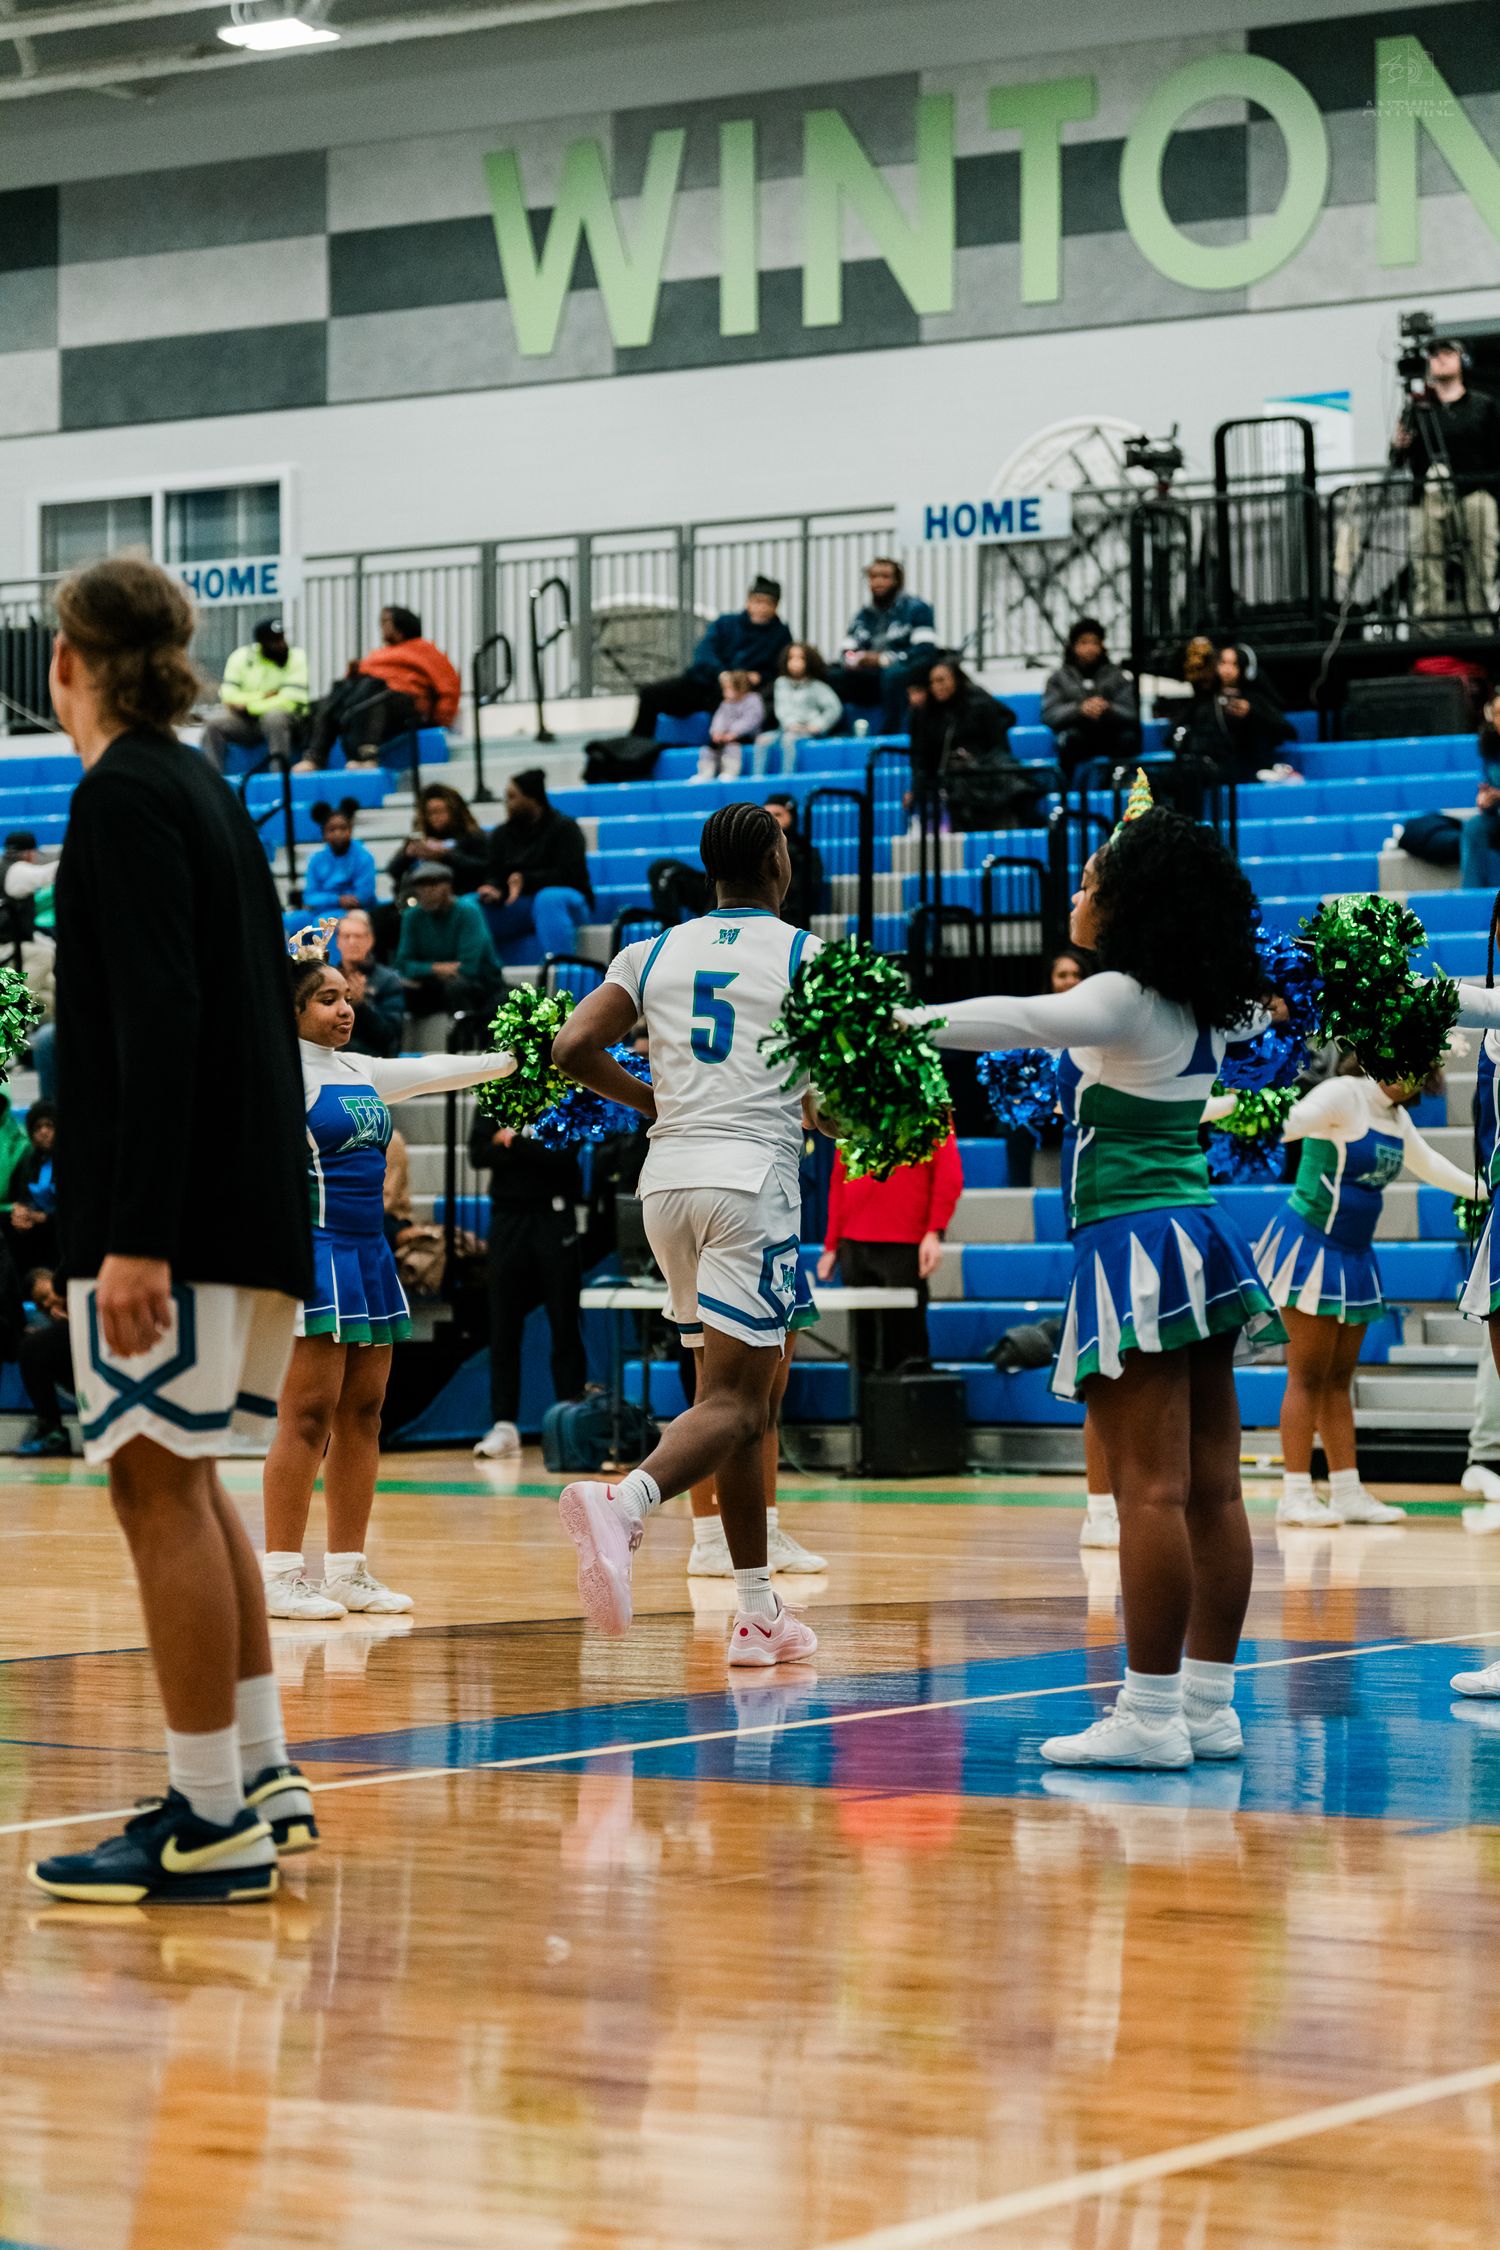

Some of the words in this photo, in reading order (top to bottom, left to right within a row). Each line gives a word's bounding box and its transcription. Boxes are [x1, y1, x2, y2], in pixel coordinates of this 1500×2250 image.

[484, 35, 1500, 357] WINTON
[924, 498, 1040, 540] HOME
[690, 970, 740, 1065] 5
